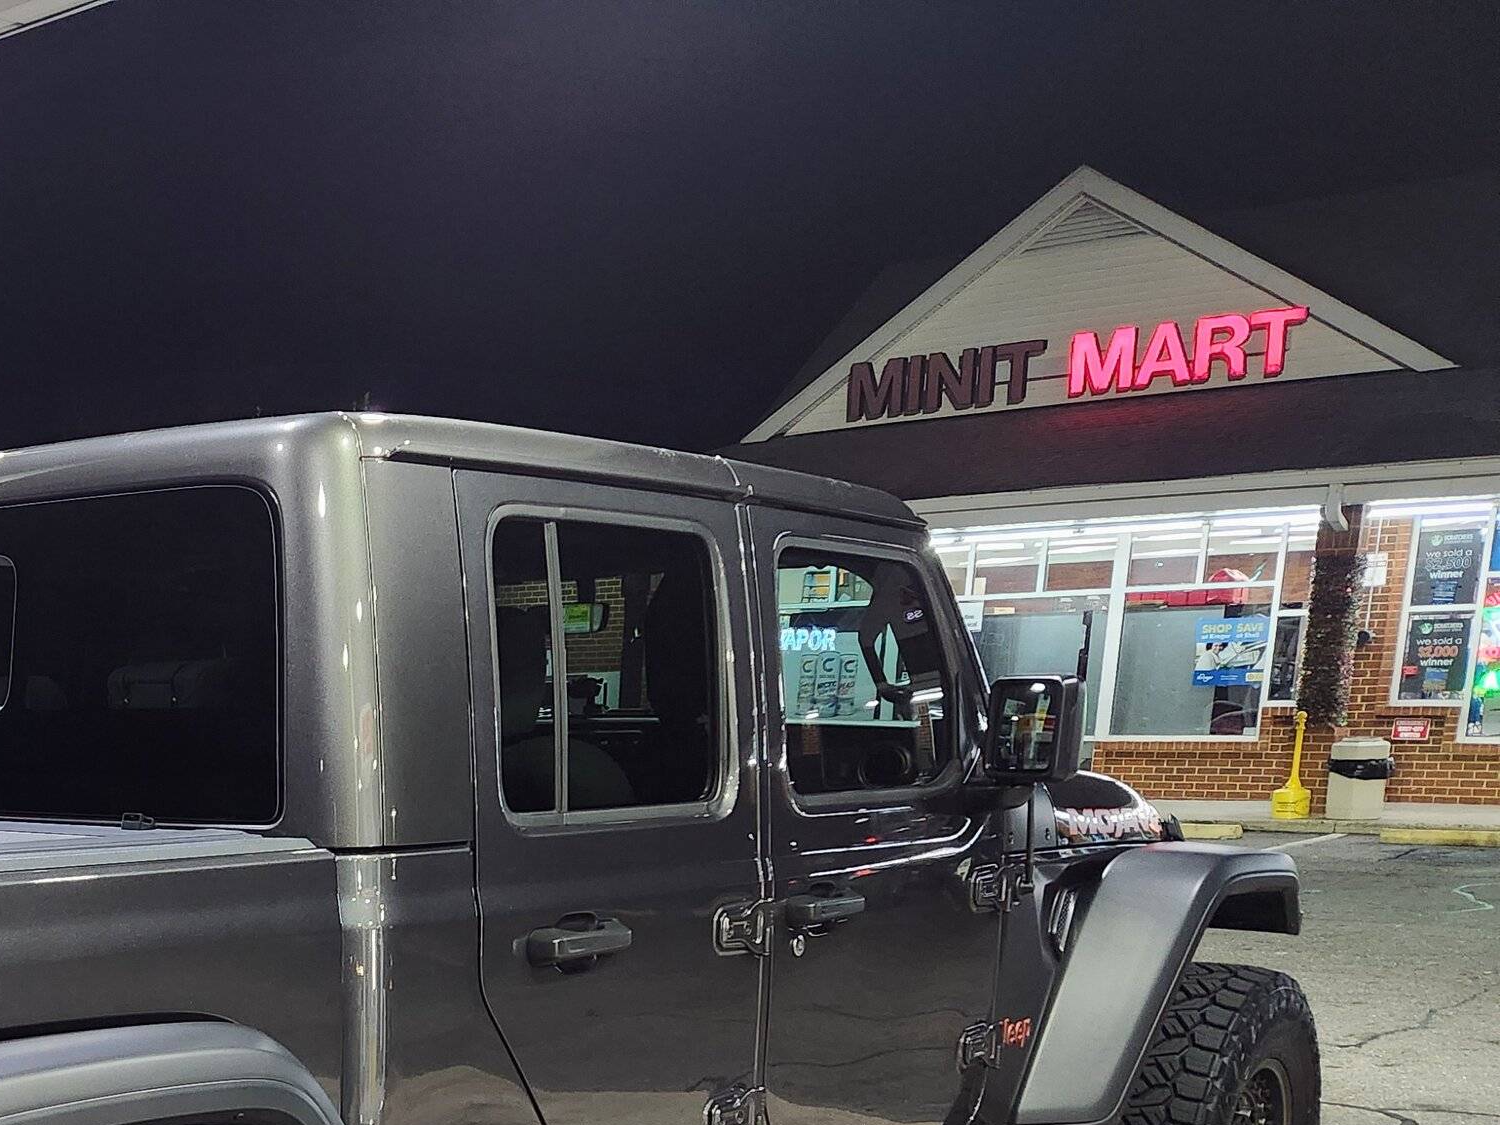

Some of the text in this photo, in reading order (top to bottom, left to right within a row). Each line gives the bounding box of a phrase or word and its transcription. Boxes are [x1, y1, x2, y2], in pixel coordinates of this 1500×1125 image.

[846, 306, 1310, 424] MINIT MART
[1443, 549, 1463, 557] sold
[1430, 570, 1464, 579] winner
[1202, 622, 1264, 634] SHOP SAVE
[1433, 637, 1452, 645] sold
[1420, 658, 1454, 666] winner
[1000, 1018, 1031, 1047] Jeep
